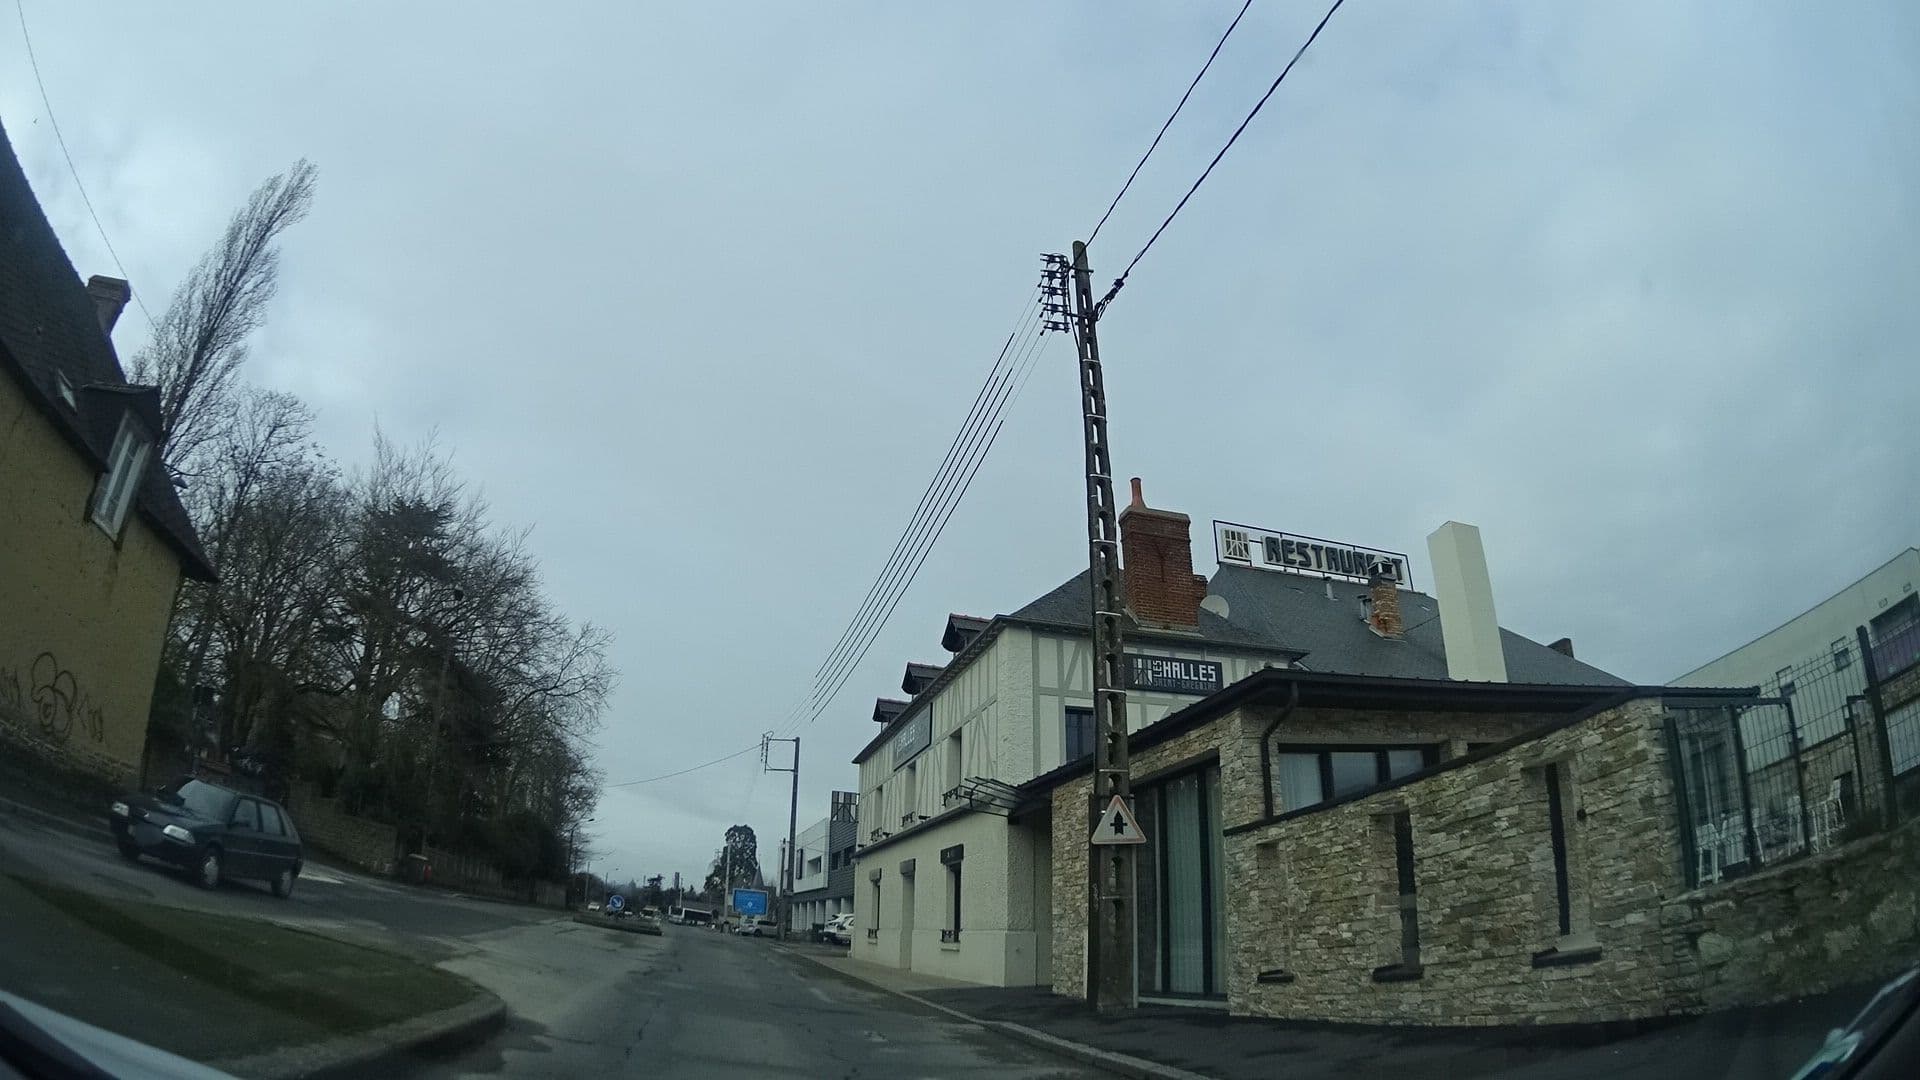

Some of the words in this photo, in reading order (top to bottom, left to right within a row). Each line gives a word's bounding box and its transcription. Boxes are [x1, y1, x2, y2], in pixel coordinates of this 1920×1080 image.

[1265, 536, 1402, 581] RESTAURT
[1153, 660, 1162, 677] LES
[1163, 662, 1216, 681] HALLES
